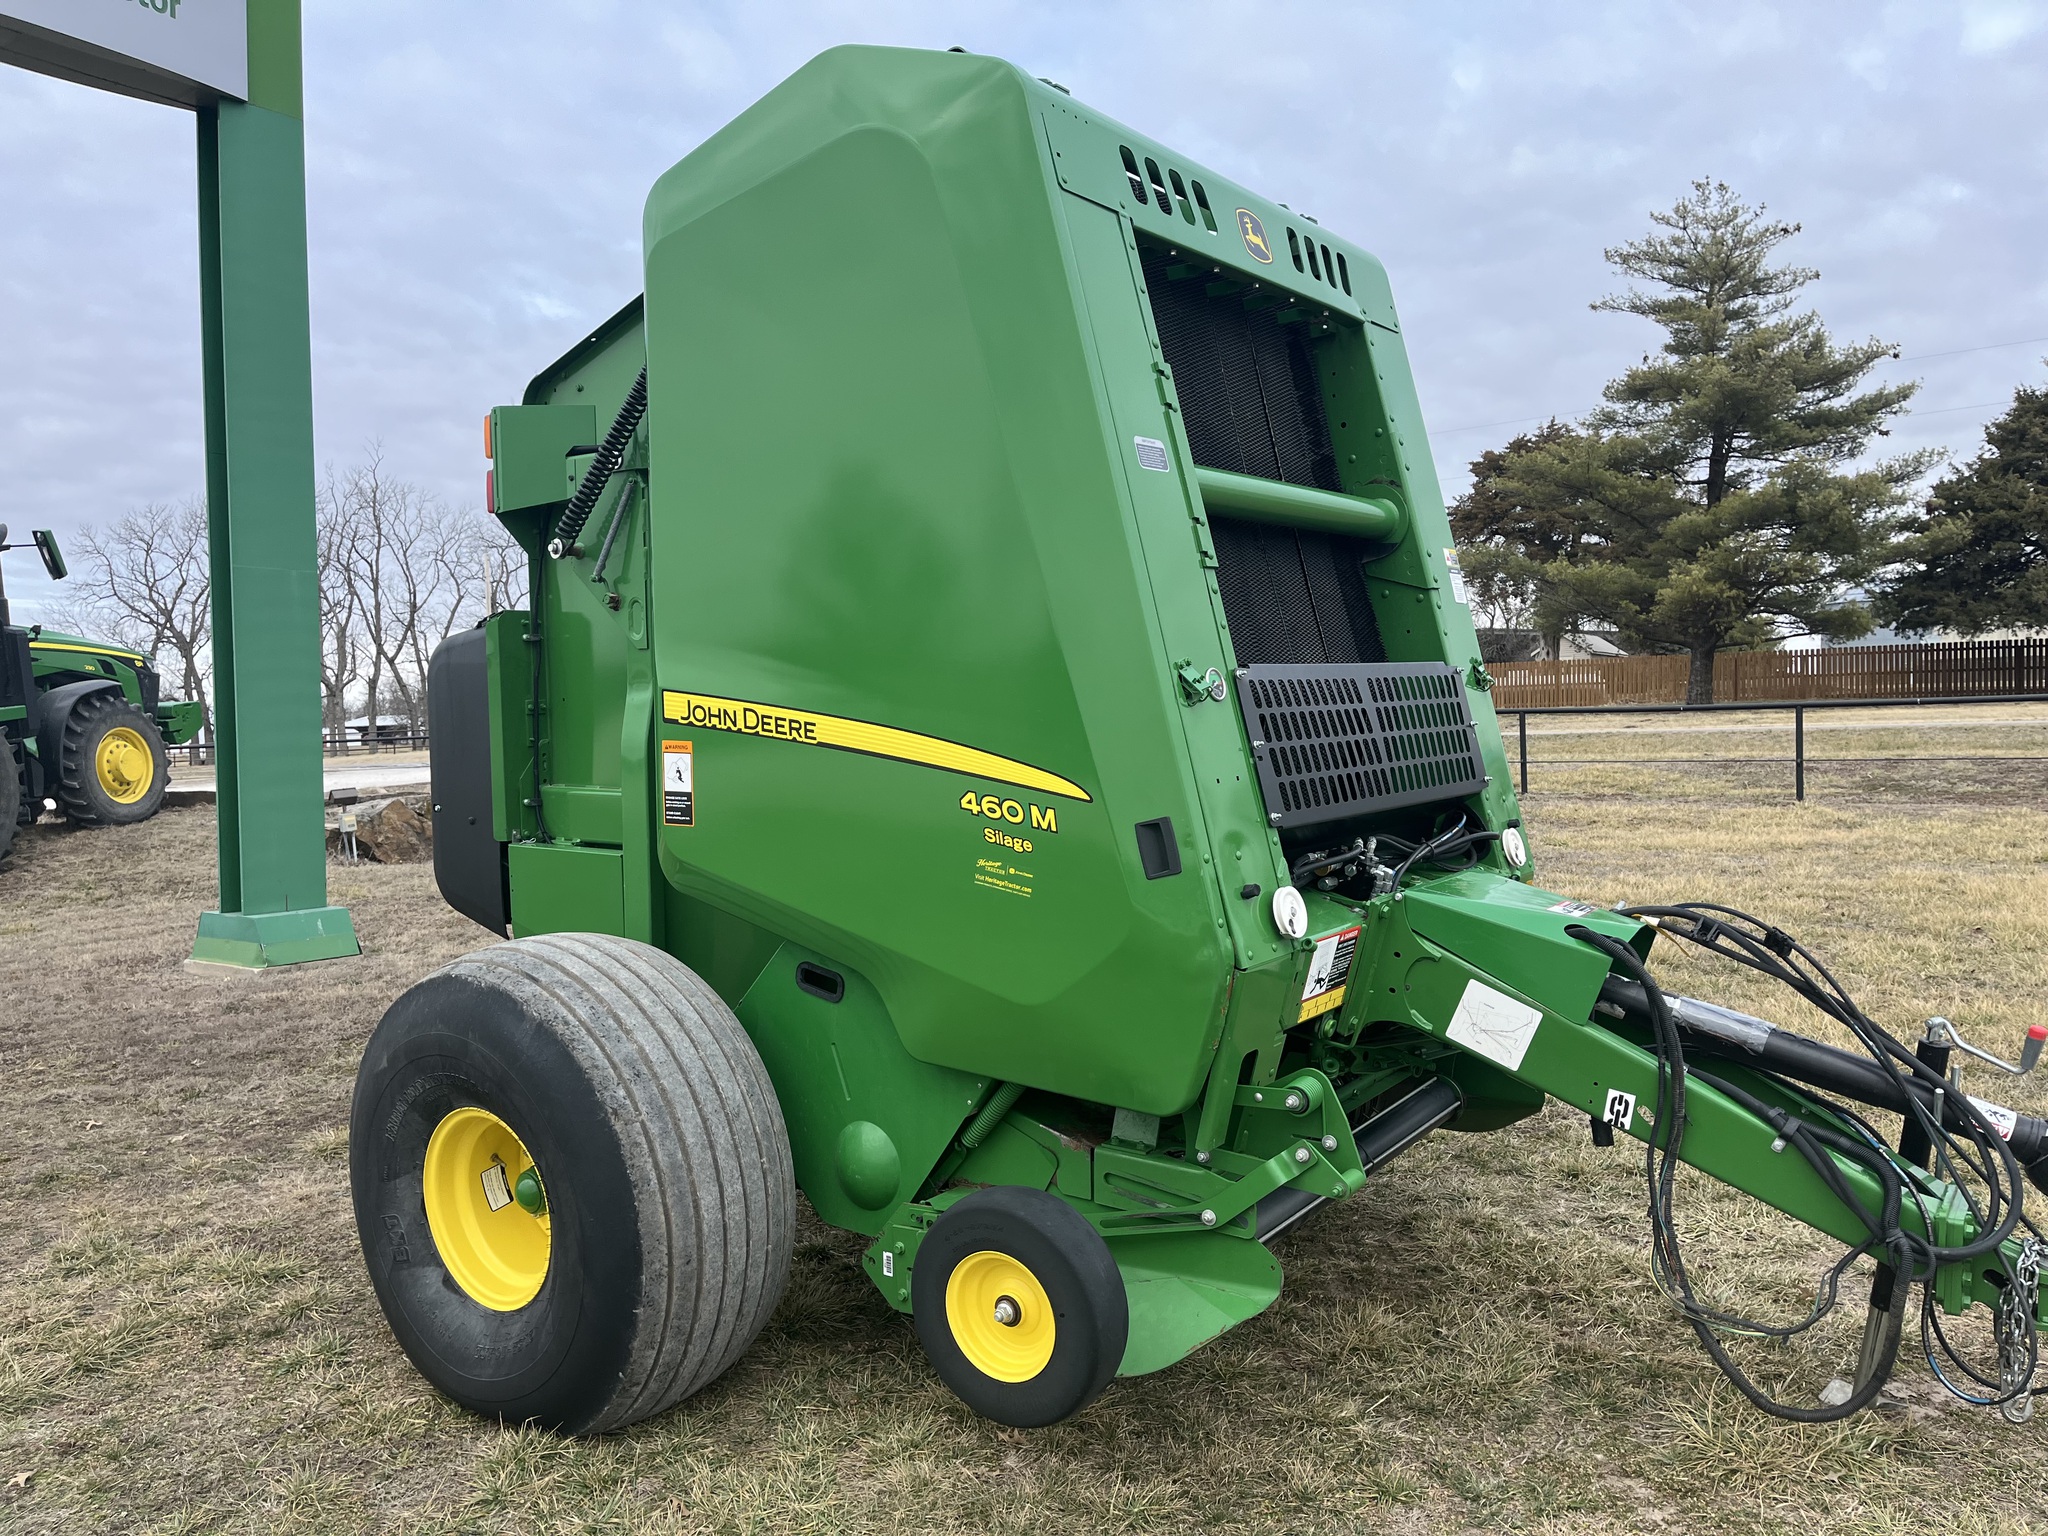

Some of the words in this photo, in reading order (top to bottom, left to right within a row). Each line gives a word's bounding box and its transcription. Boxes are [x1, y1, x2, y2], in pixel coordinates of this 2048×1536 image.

[680, 700, 737, 728] JOHN
[743, 707, 817, 741] DEERE
[959, 790, 1025, 825] 460
[1029, 803, 1058, 834] M
[983, 827, 1033, 853] Silage
[975, 873, 985, 881] Visit
[985, 876, 1032, 893] HeritageTractor.com
